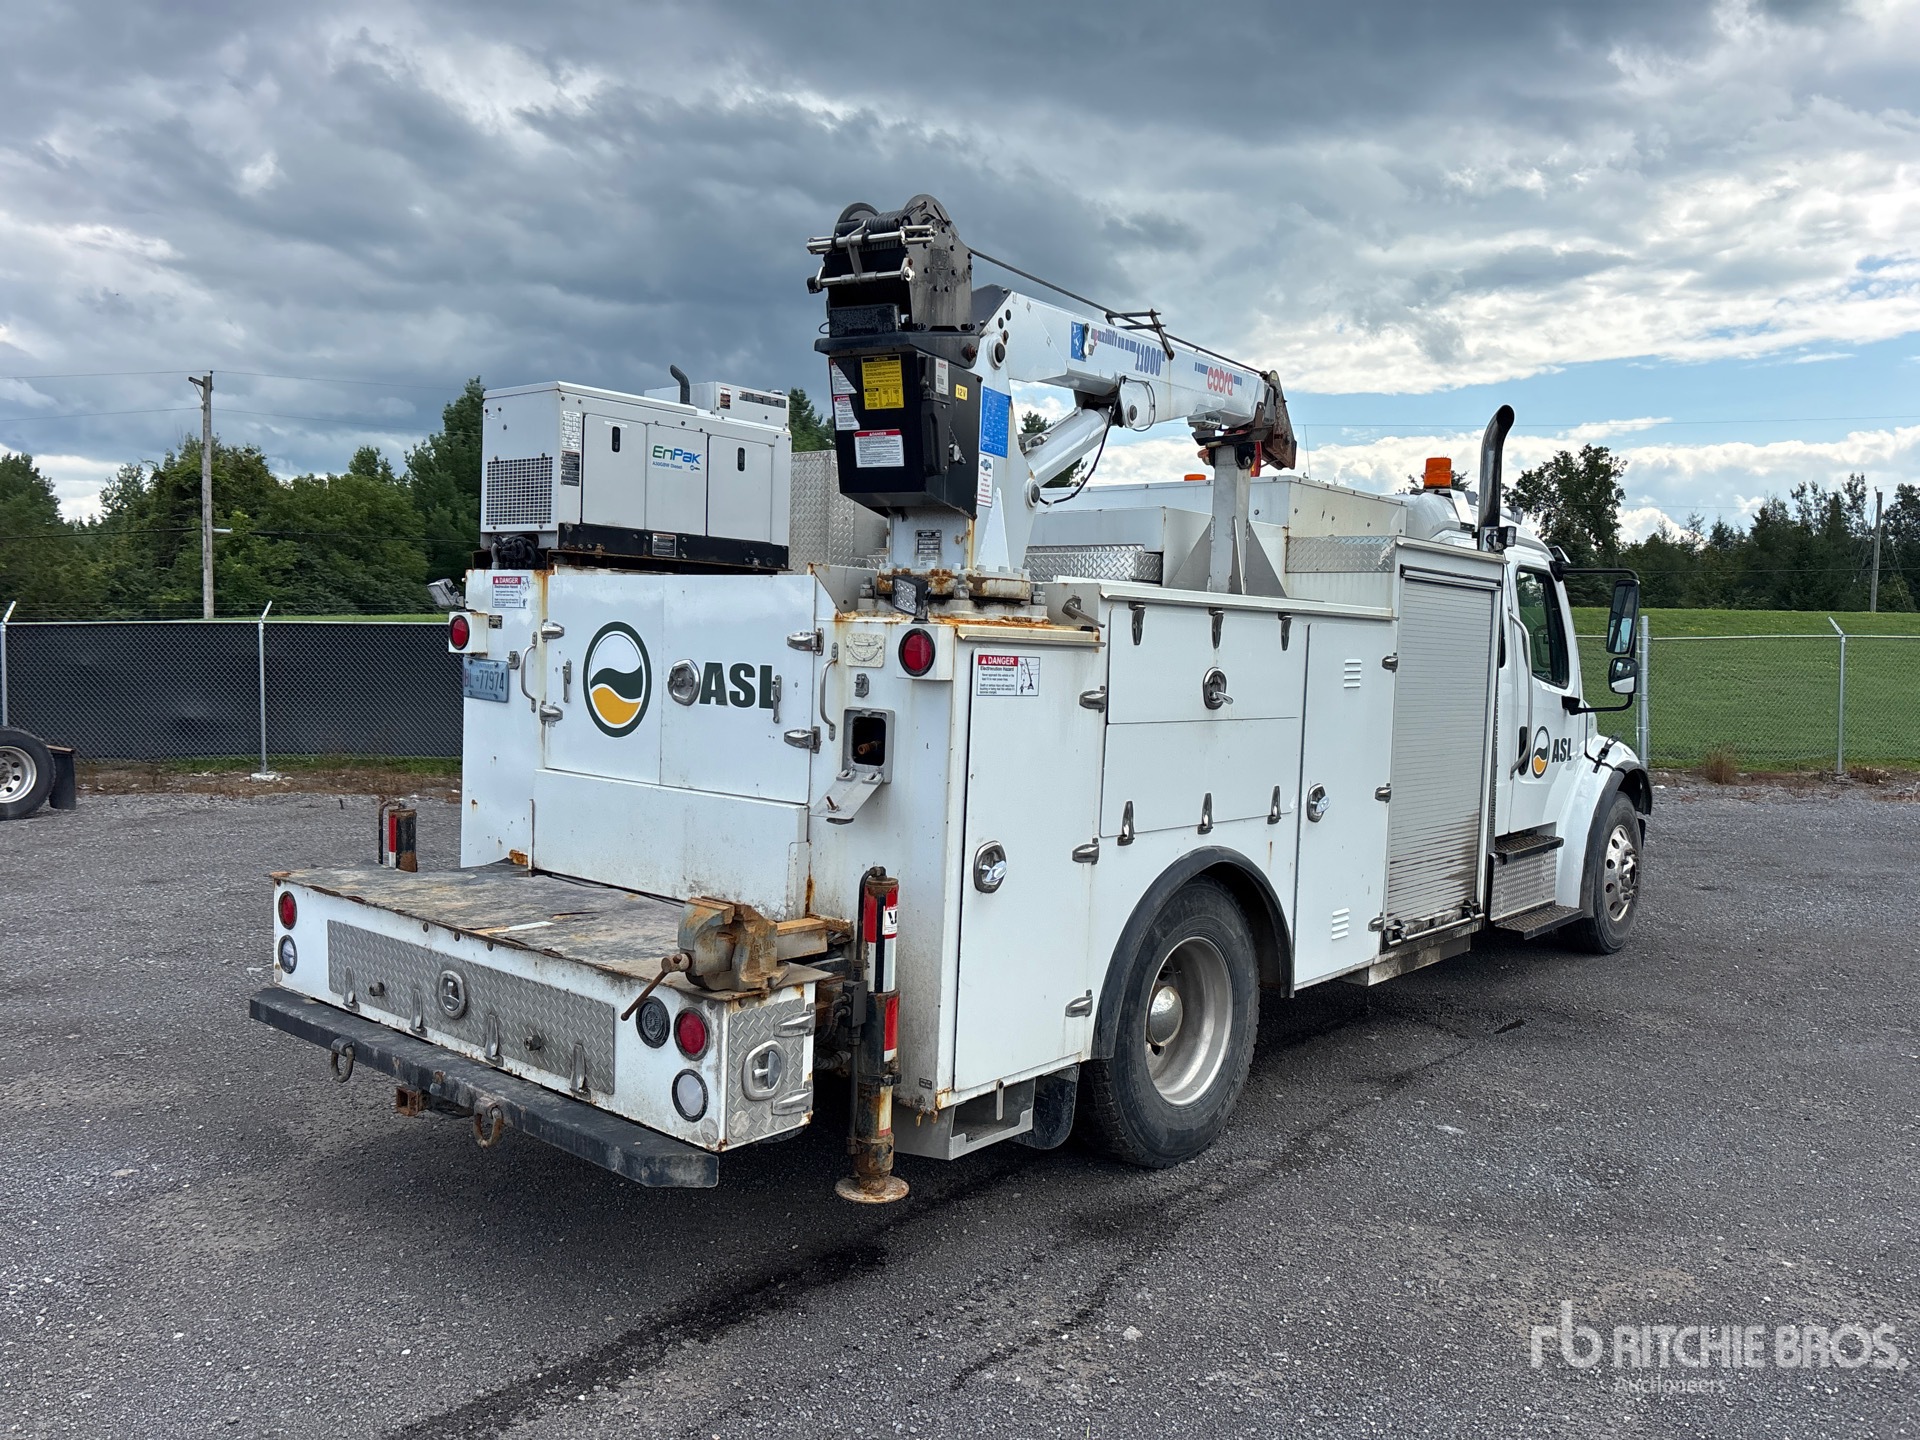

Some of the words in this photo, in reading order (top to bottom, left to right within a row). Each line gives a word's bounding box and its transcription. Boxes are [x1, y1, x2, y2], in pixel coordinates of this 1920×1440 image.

[1135, 342, 1161, 377] 11000
[957, 387, 966, 398] 12V
[1207, 366, 1233, 396] cobra
[652, 445, 703, 465] EnPak
[988, 656, 1015, 665] DANGER
[479, 669, 505, 692] 77974
[1551, 738, 1572, 763] ASL
